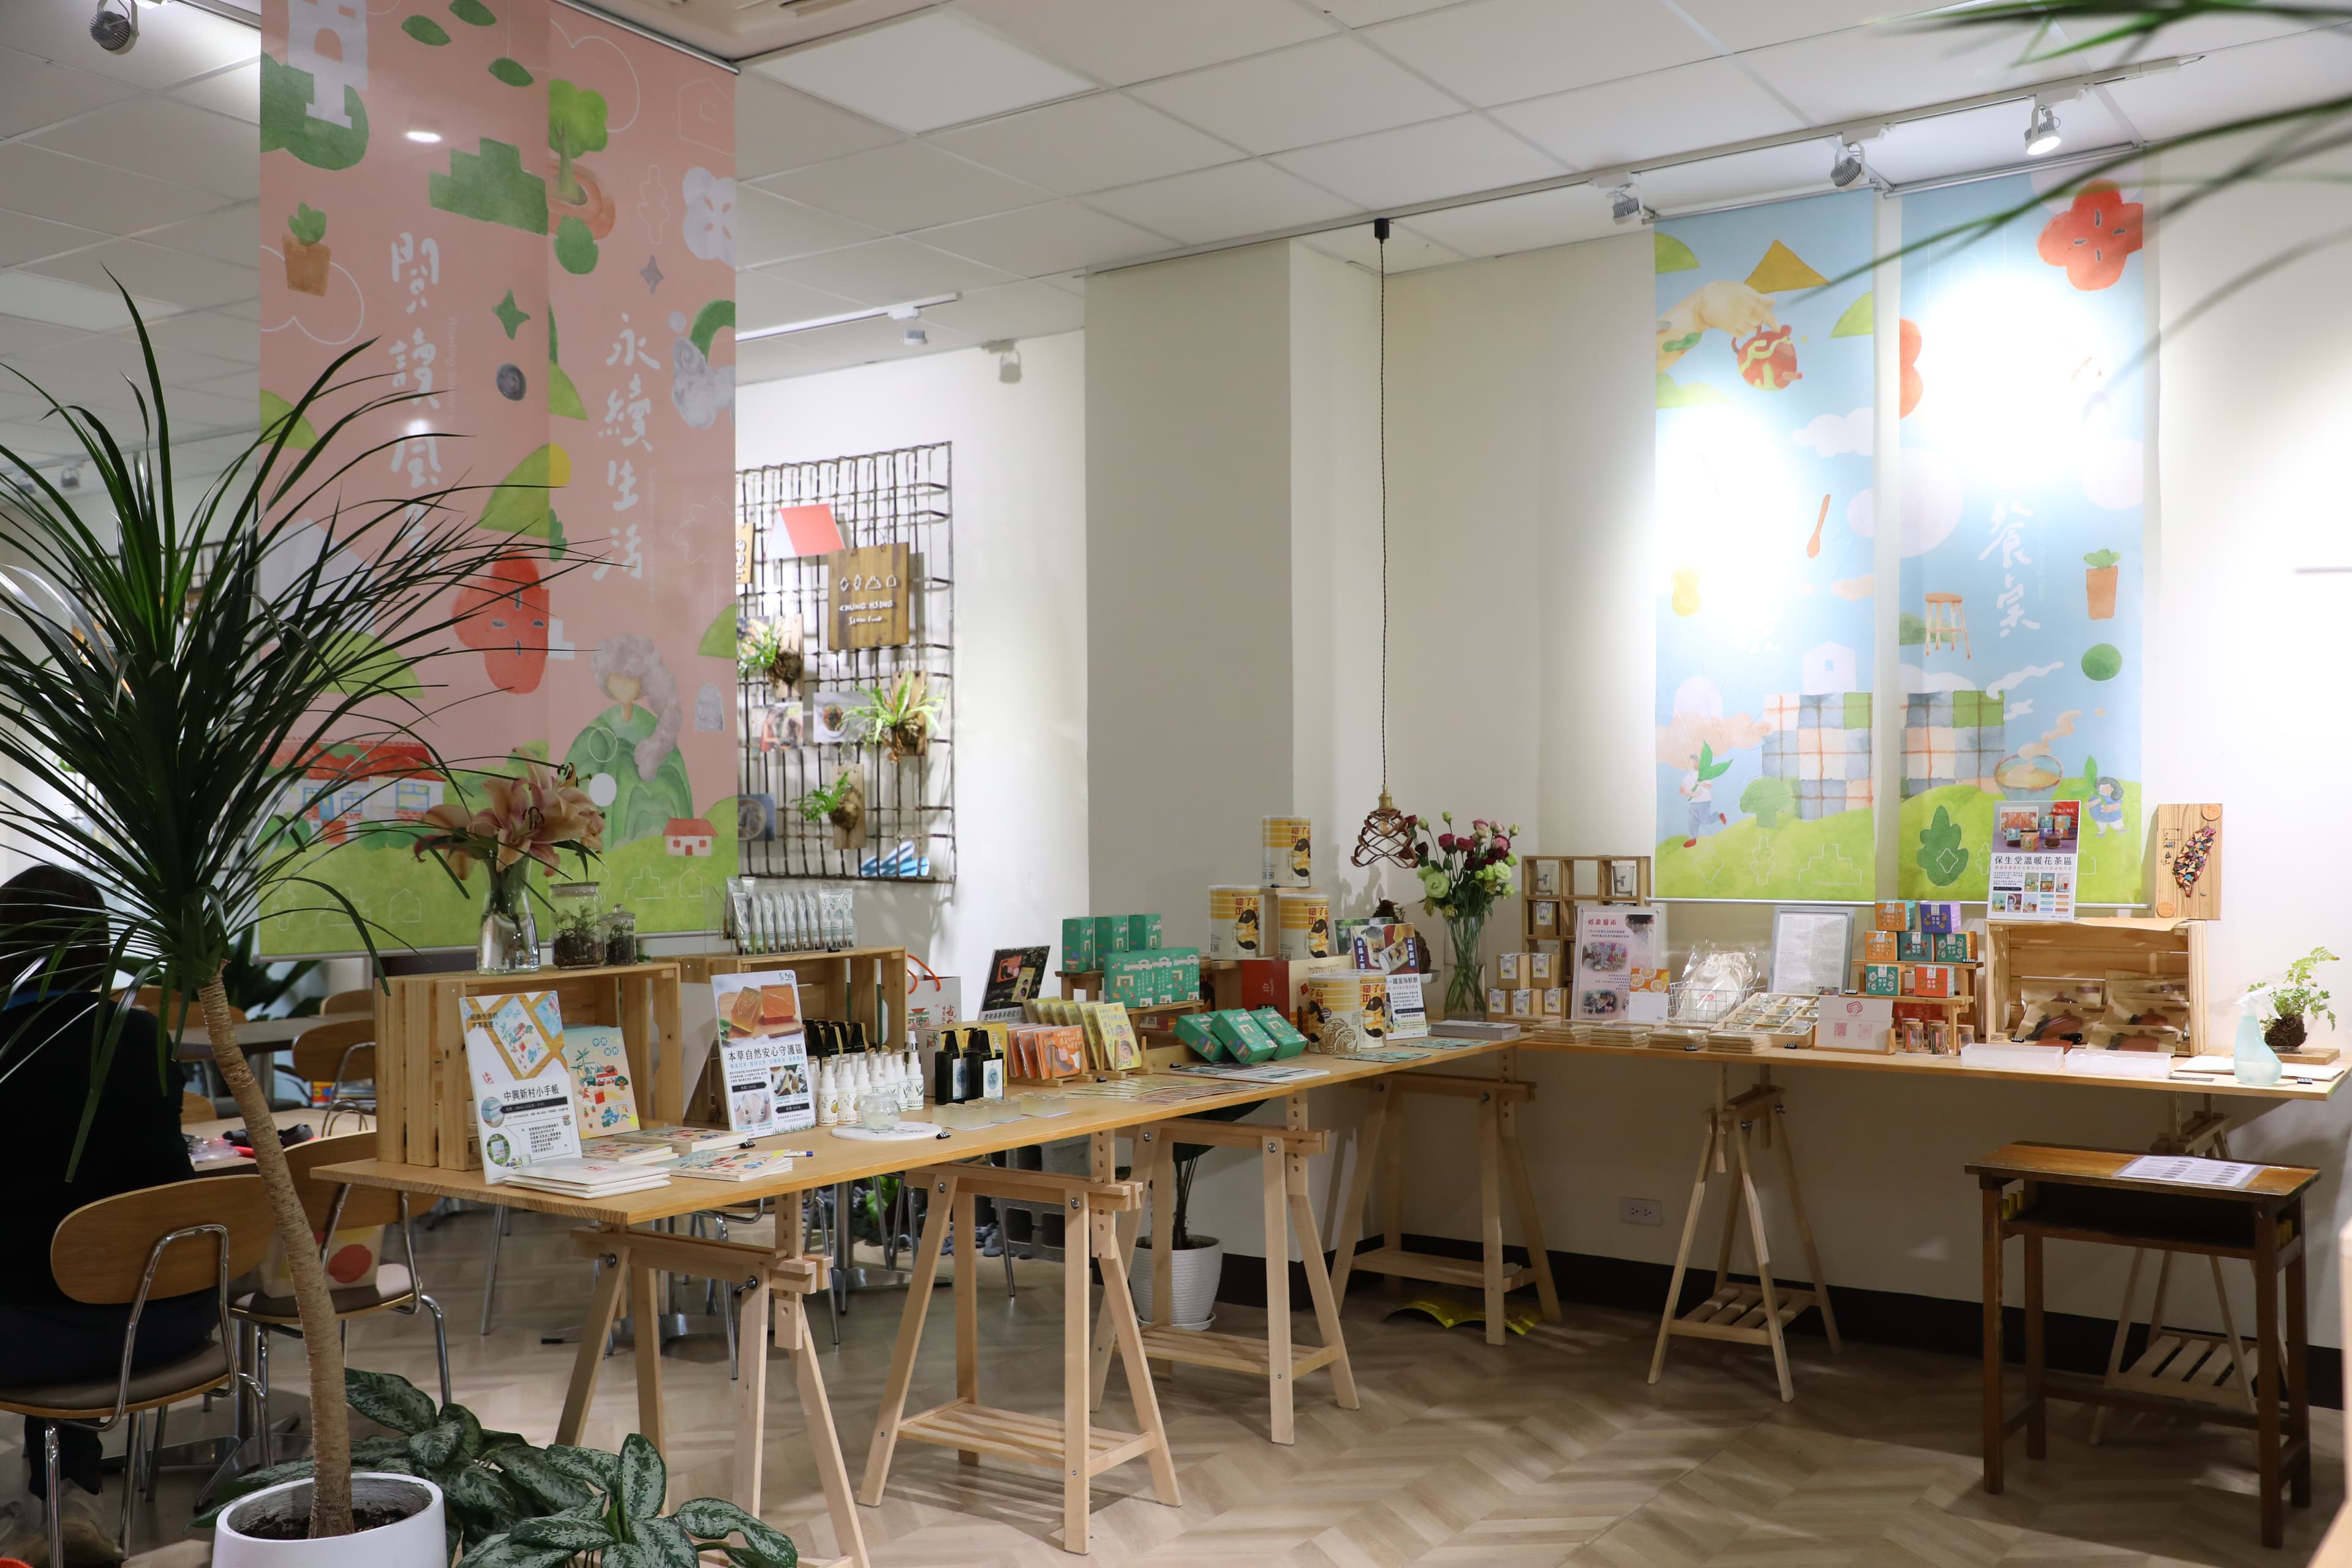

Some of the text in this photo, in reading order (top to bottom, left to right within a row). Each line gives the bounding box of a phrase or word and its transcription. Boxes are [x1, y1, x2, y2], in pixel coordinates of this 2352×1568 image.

[592, 312, 661, 581] 永續生活
[839, 602, 866, 611] CHUNG
[1995, 856, 2072, 865] 保生堂溫暖花茶區
[728, 1043, 804, 1062] 本草自然安心守護區
[503, 1084, 560, 1102] 中興新村小手帳
